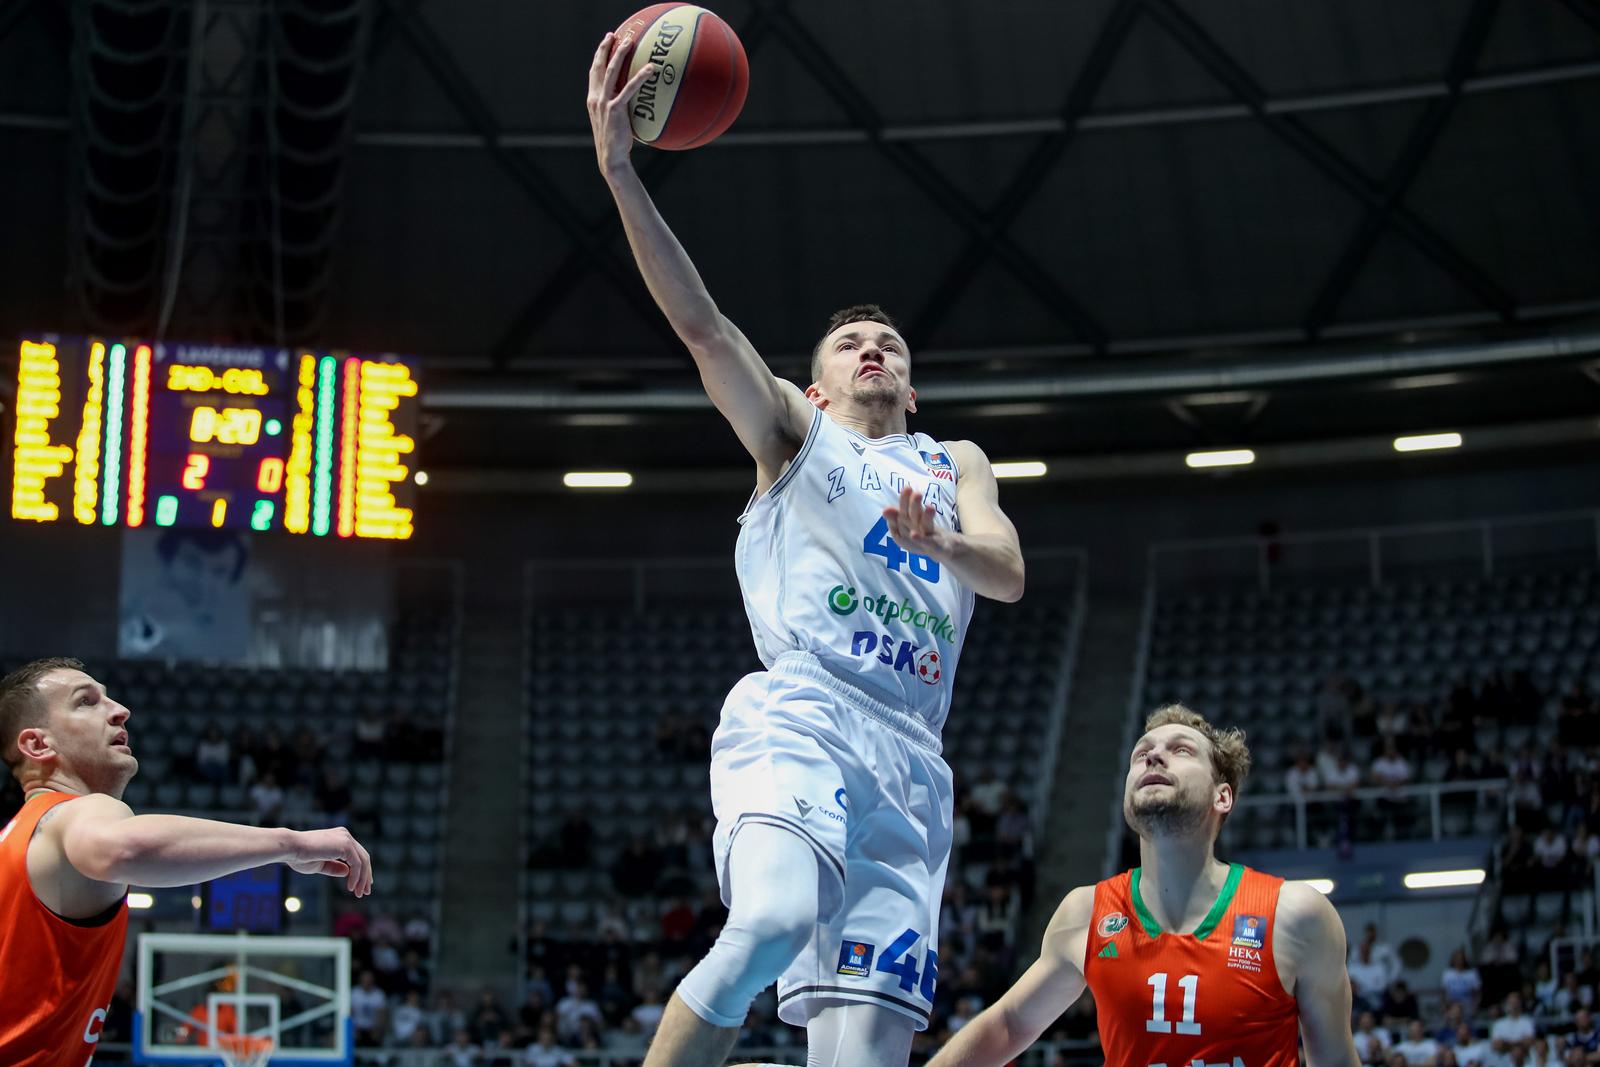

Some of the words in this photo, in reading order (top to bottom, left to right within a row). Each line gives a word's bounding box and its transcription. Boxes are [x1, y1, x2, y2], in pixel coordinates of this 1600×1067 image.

[182, 453, 210, 490] 2
[257, 457, 284, 493] 0
[251, 500, 275, 531] 2
[1229, 946, 1262, 961] HEKA
[1146, 972, 1202, 1036] 11
